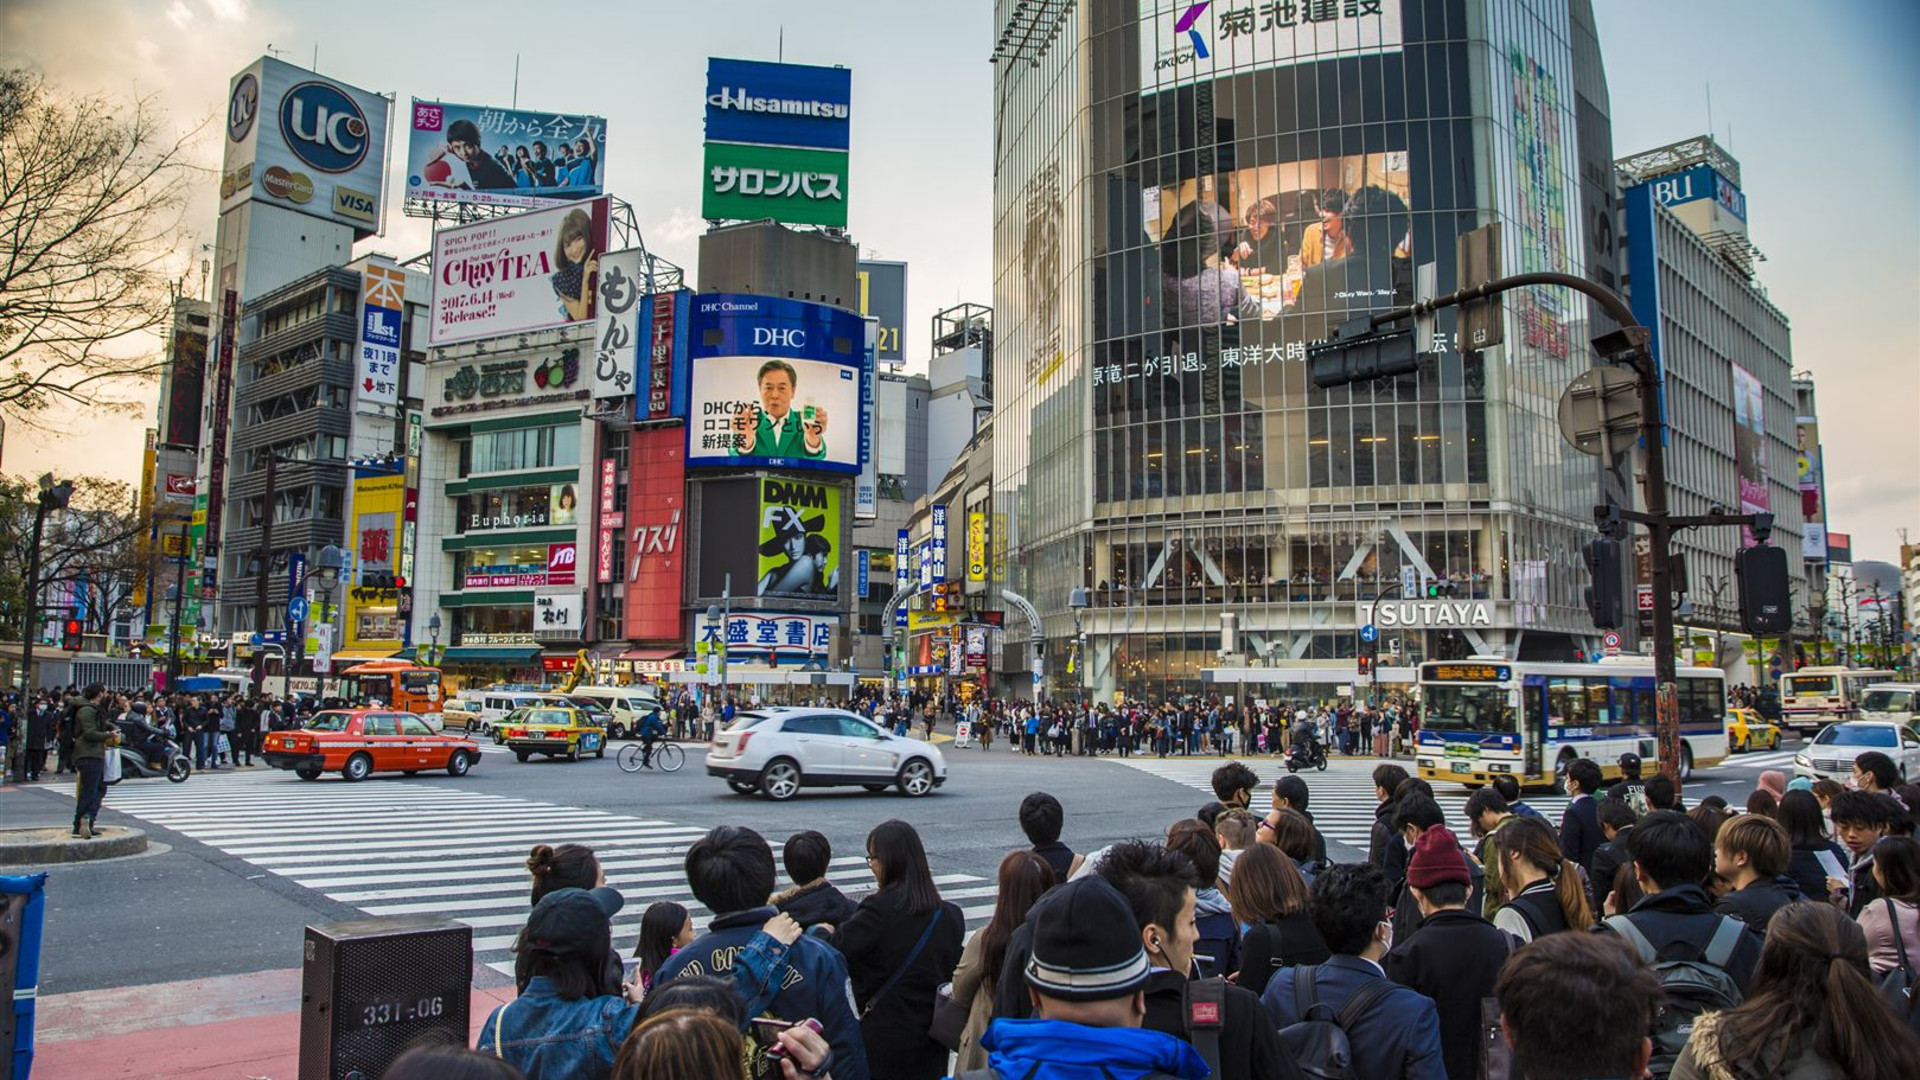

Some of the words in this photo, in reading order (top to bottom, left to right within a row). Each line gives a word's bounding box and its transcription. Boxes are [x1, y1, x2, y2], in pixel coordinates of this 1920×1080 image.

[1153, 51, 1197, 72] KIKUCH
[417, 106, 441, 119] あさ
[708, 86, 849, 119] Hisamitsu
[291, 97, 361, 154] UC
[416, 117, 440, 128] チャン
[265, 173, 313, 194] MasterCard
[711, 165, 842, 201] サロンパス
[339, 194, 375, 216] VISA
[444, 236, 468, 247] SPICY
[470, 229, 497, 242] POP!!
[441, 290, 492, 311] 2017.6.14
[701, 304, 720, 312] DHC
[721, 302, 758, 311] Channel
[441, 304, 496, 325] Release!!
[596, 265, 636, 392] もんじゃ
[754, 327, 805, 348] DHC
[363, 346, 397, 364] 夜11時
[369, 362, 390, 375] まで
[375, 381, 395, 394] 地下
[703, 400, 768, 415] DHCから、
[702, 433, 747, 449] 新提案
[764, 481, 828, 509] DMM
[471, 512, 545, 529] Euphoria
[763, 507, 805, 532] FX
[550, 547, 575, 567] JTB
[1362, 603, 1490, 626] TSUTAYA
[702, 619, 829, 645] 大盛堂書店
